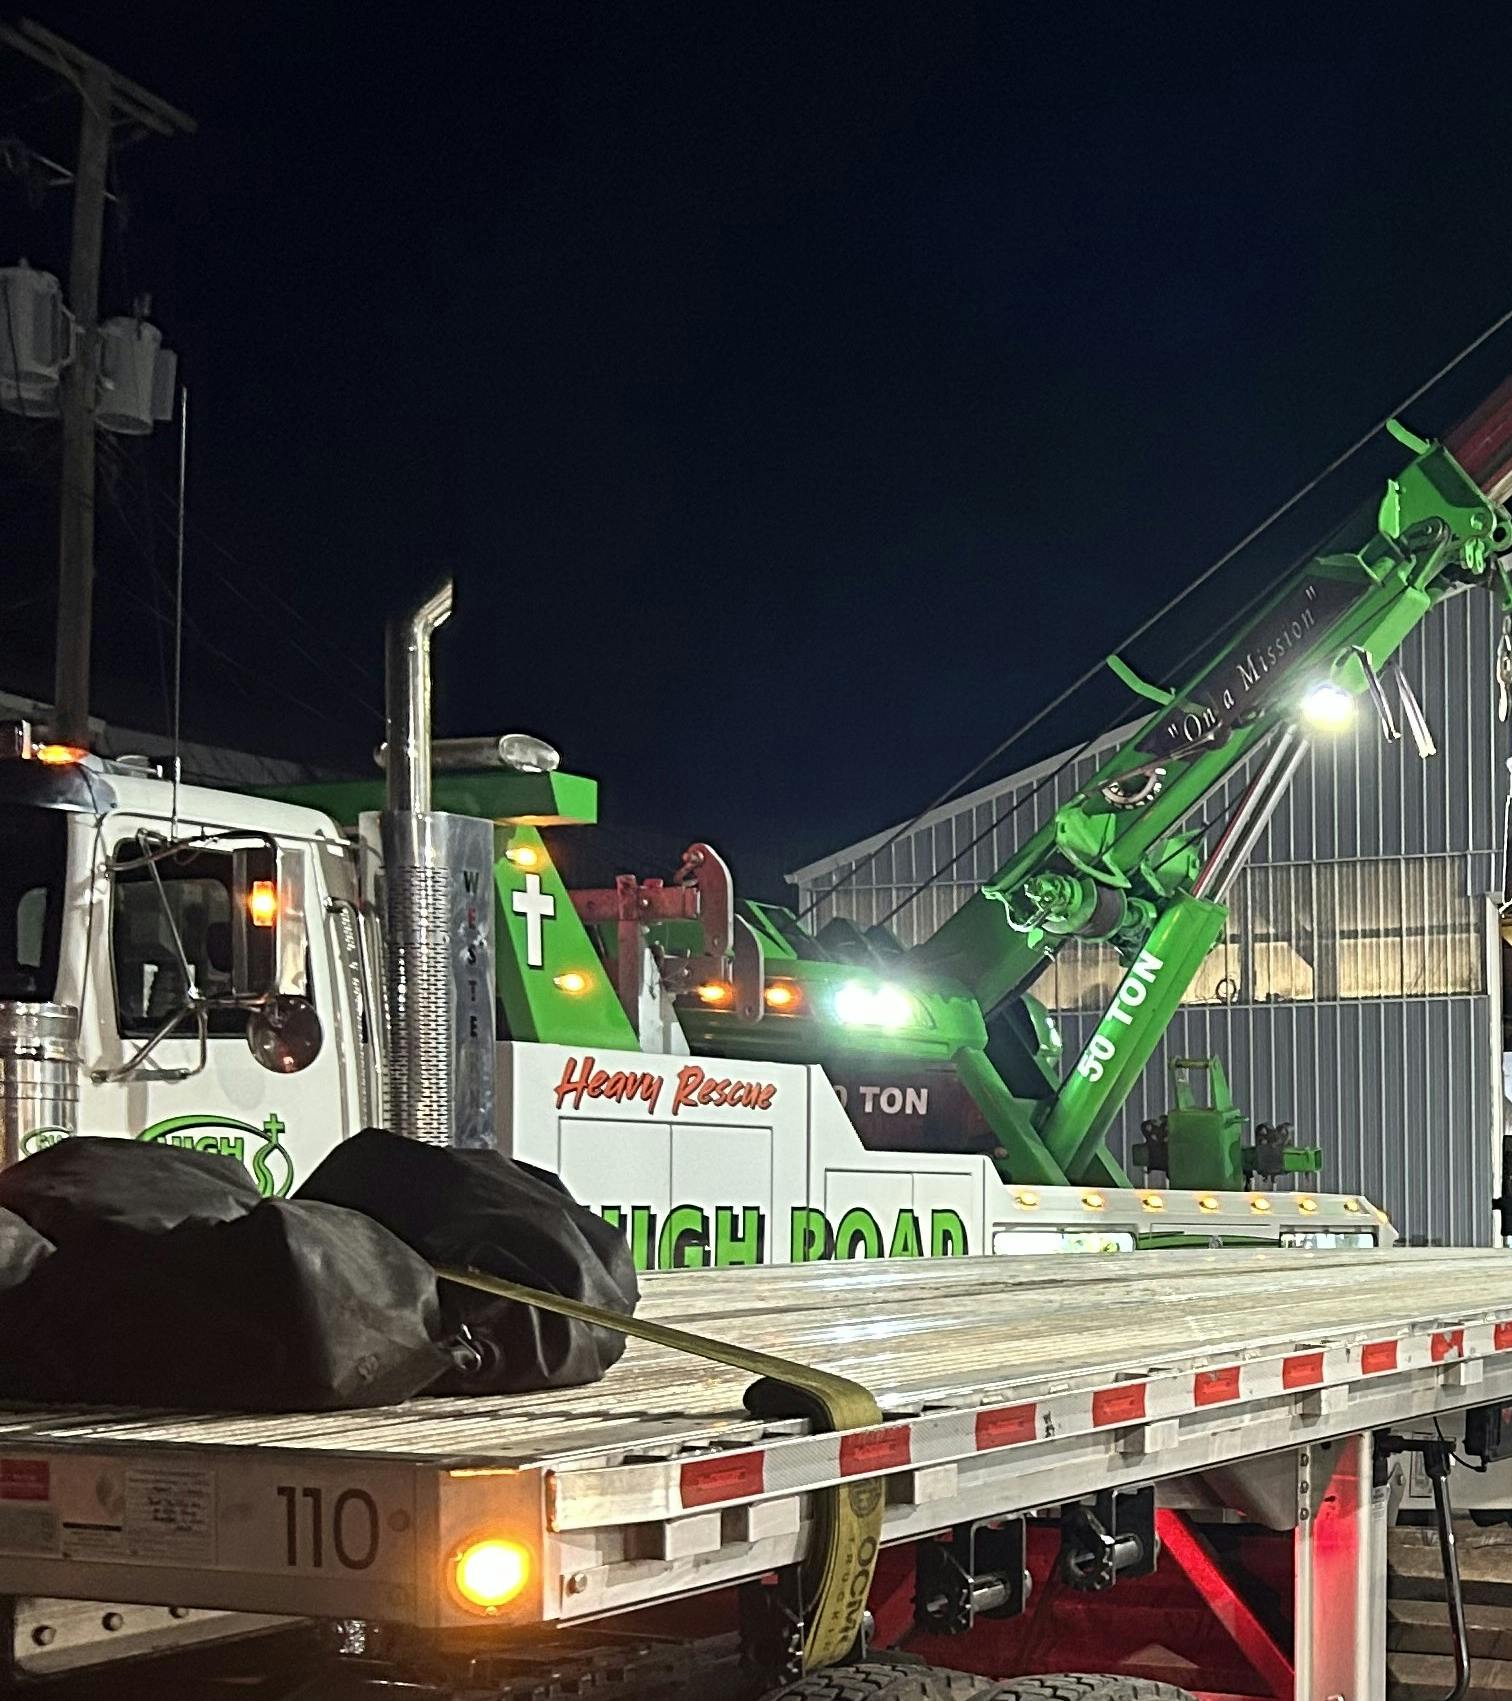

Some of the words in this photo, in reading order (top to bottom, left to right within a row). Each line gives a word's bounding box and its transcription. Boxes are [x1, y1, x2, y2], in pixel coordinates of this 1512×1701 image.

[1223, 689, 1235, 709] a
[1077, 1034, 1116, 1082] 50
[1105, 950, 1164, 1025] TON
[554, 1056, 663, 1115] Heavy
[672, 1065, 777, 1116] Rescue
[860, 1086, 928, 1115] TON
[585, 1204, 765, 1271] IGH
[791, 1207, 968, 1262] ROAD
[277, 1486, 380, 1570] 110
